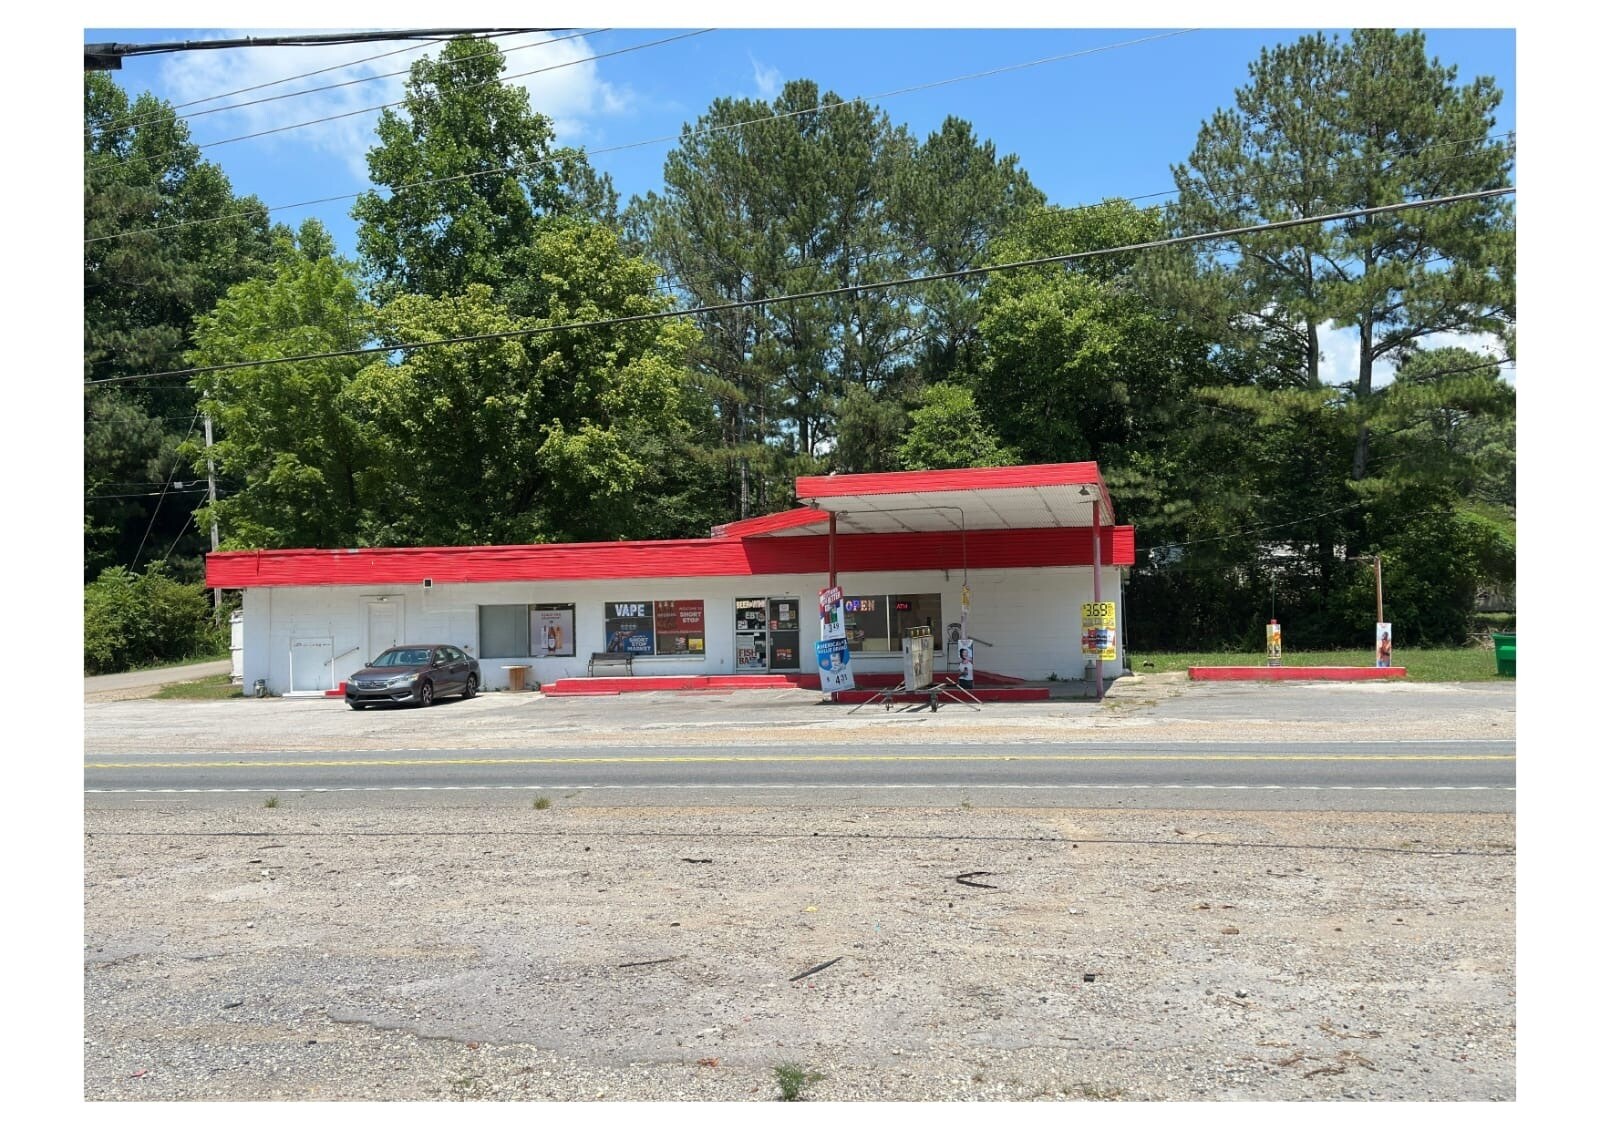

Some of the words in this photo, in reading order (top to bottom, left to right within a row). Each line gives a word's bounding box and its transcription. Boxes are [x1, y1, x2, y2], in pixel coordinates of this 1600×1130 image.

[615, 604, 646, 616] VAPE
[846, 600, 874, 612] OPEN
[746, 612, 758, 620] EBT
[738, 649, 757, 658] FISH
